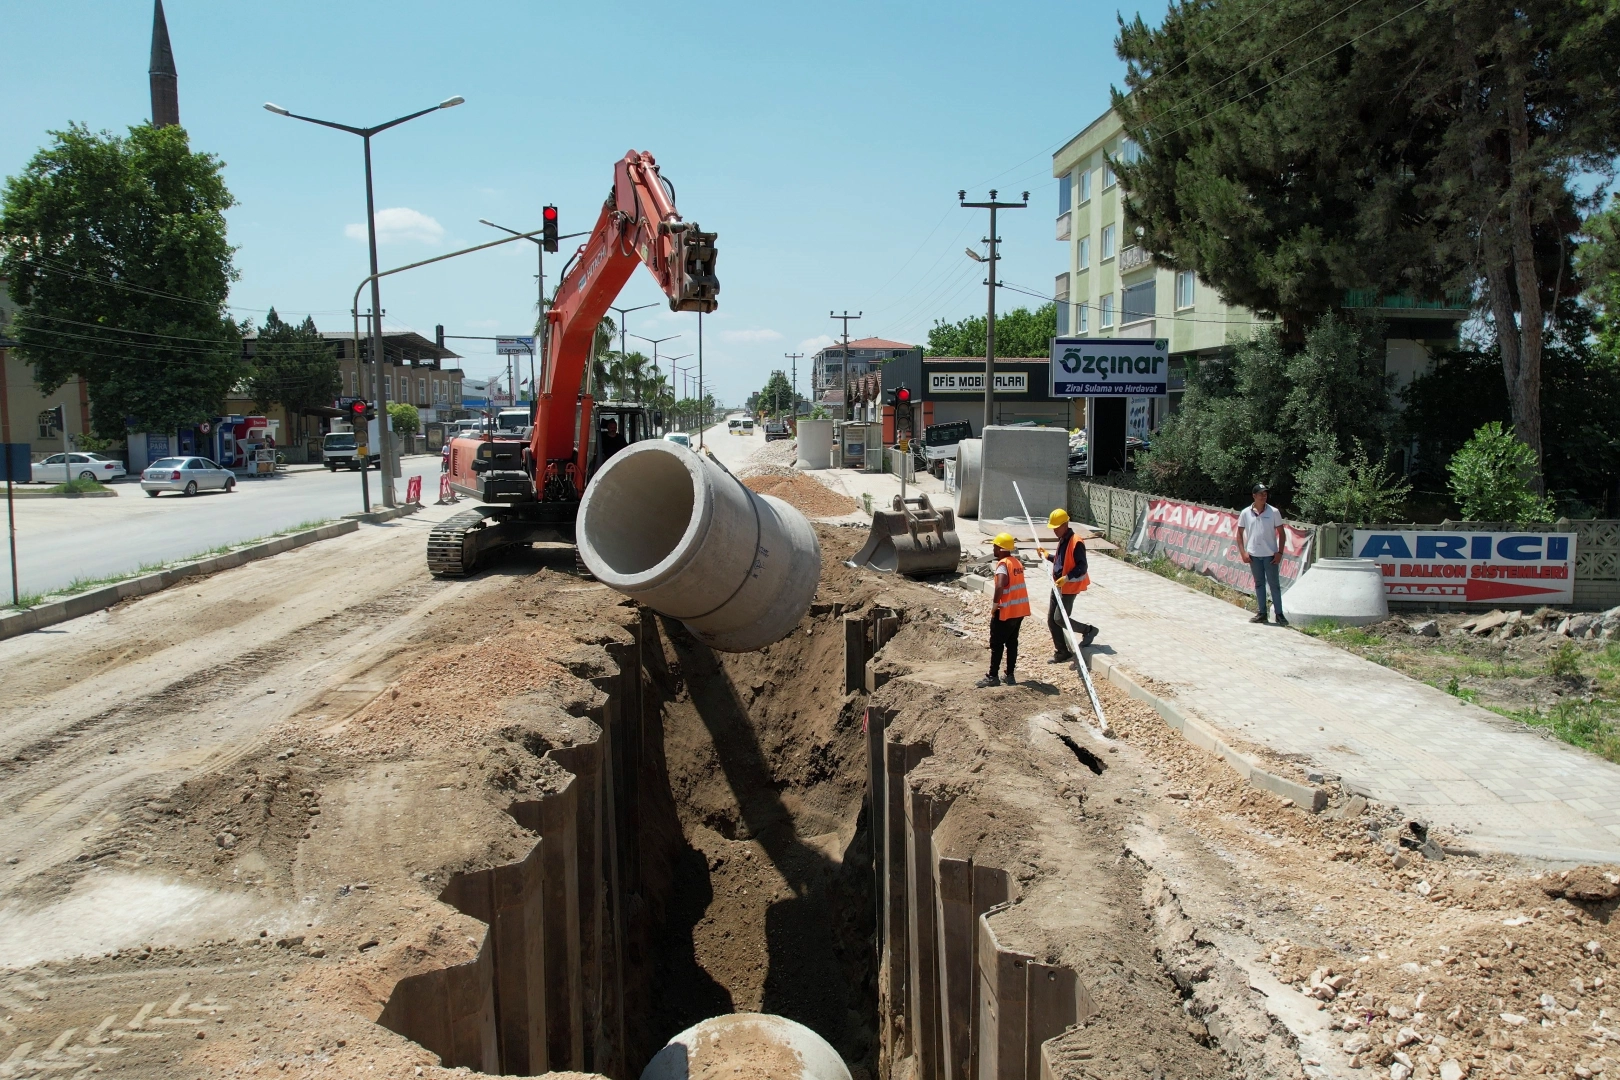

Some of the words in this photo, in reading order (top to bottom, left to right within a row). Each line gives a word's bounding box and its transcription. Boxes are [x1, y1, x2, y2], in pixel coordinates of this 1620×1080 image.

[586, 245, 607, 279] HITACHI
[1059, 347, 1165, 381] Özçınar
[933, 374, 955, 387] OFİS
[959, 374, 1025, 387] MOBİALARI
[1084, 384, 1113, 393] Sulama
[1125, 385, 1158, 393] Hırdavat
[1153, 501, 1295, 553] KAMPAA
[1358, 534, 1569, 561] ARICI
[1400, 563, 1467, 578] BALKON
[1471, 561, 1569, 579] SİSTEMLERİ
[1384, 585, 1465, 595] ALATI
